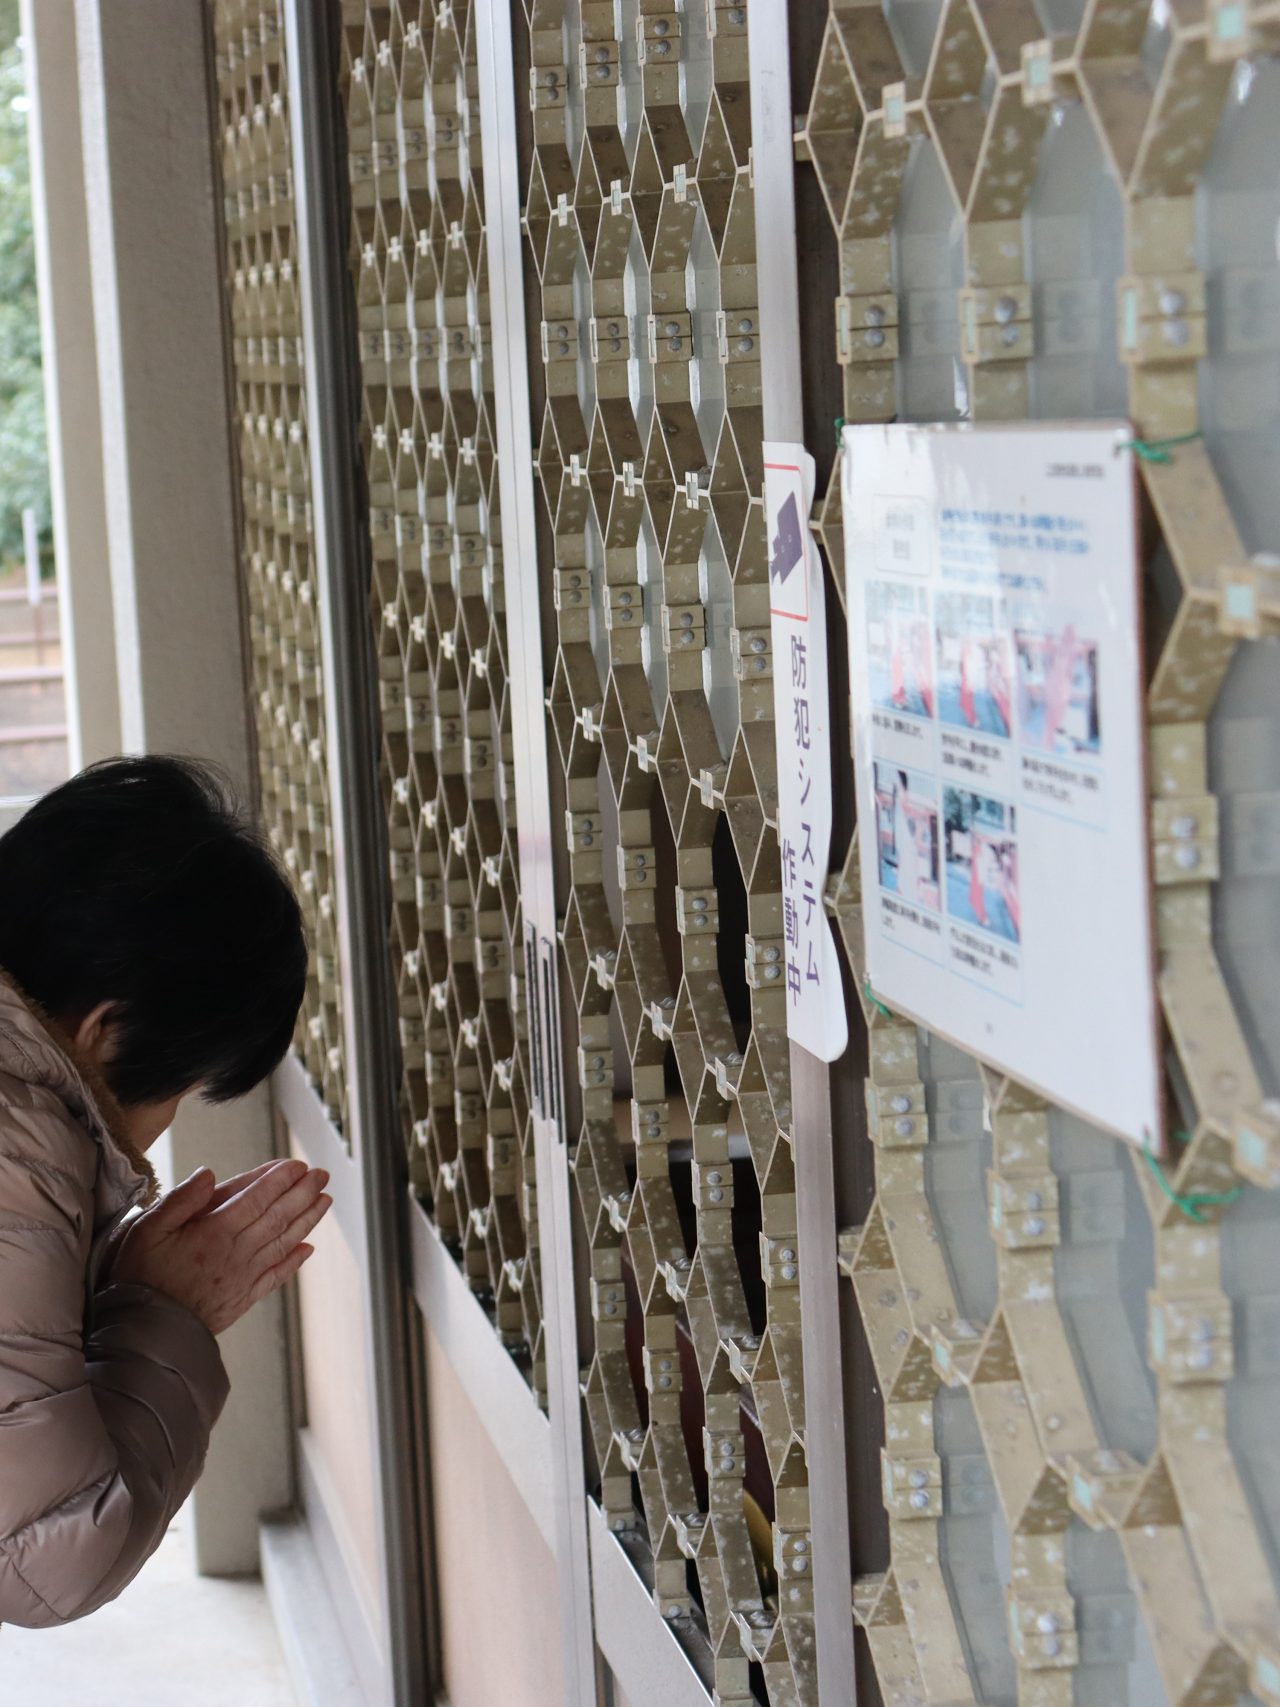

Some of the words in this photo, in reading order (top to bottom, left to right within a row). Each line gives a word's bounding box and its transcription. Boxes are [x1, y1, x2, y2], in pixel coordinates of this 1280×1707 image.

[782, 838, 801, 1006] 作動中
[791, 635, 820, 986] 防犯システム
